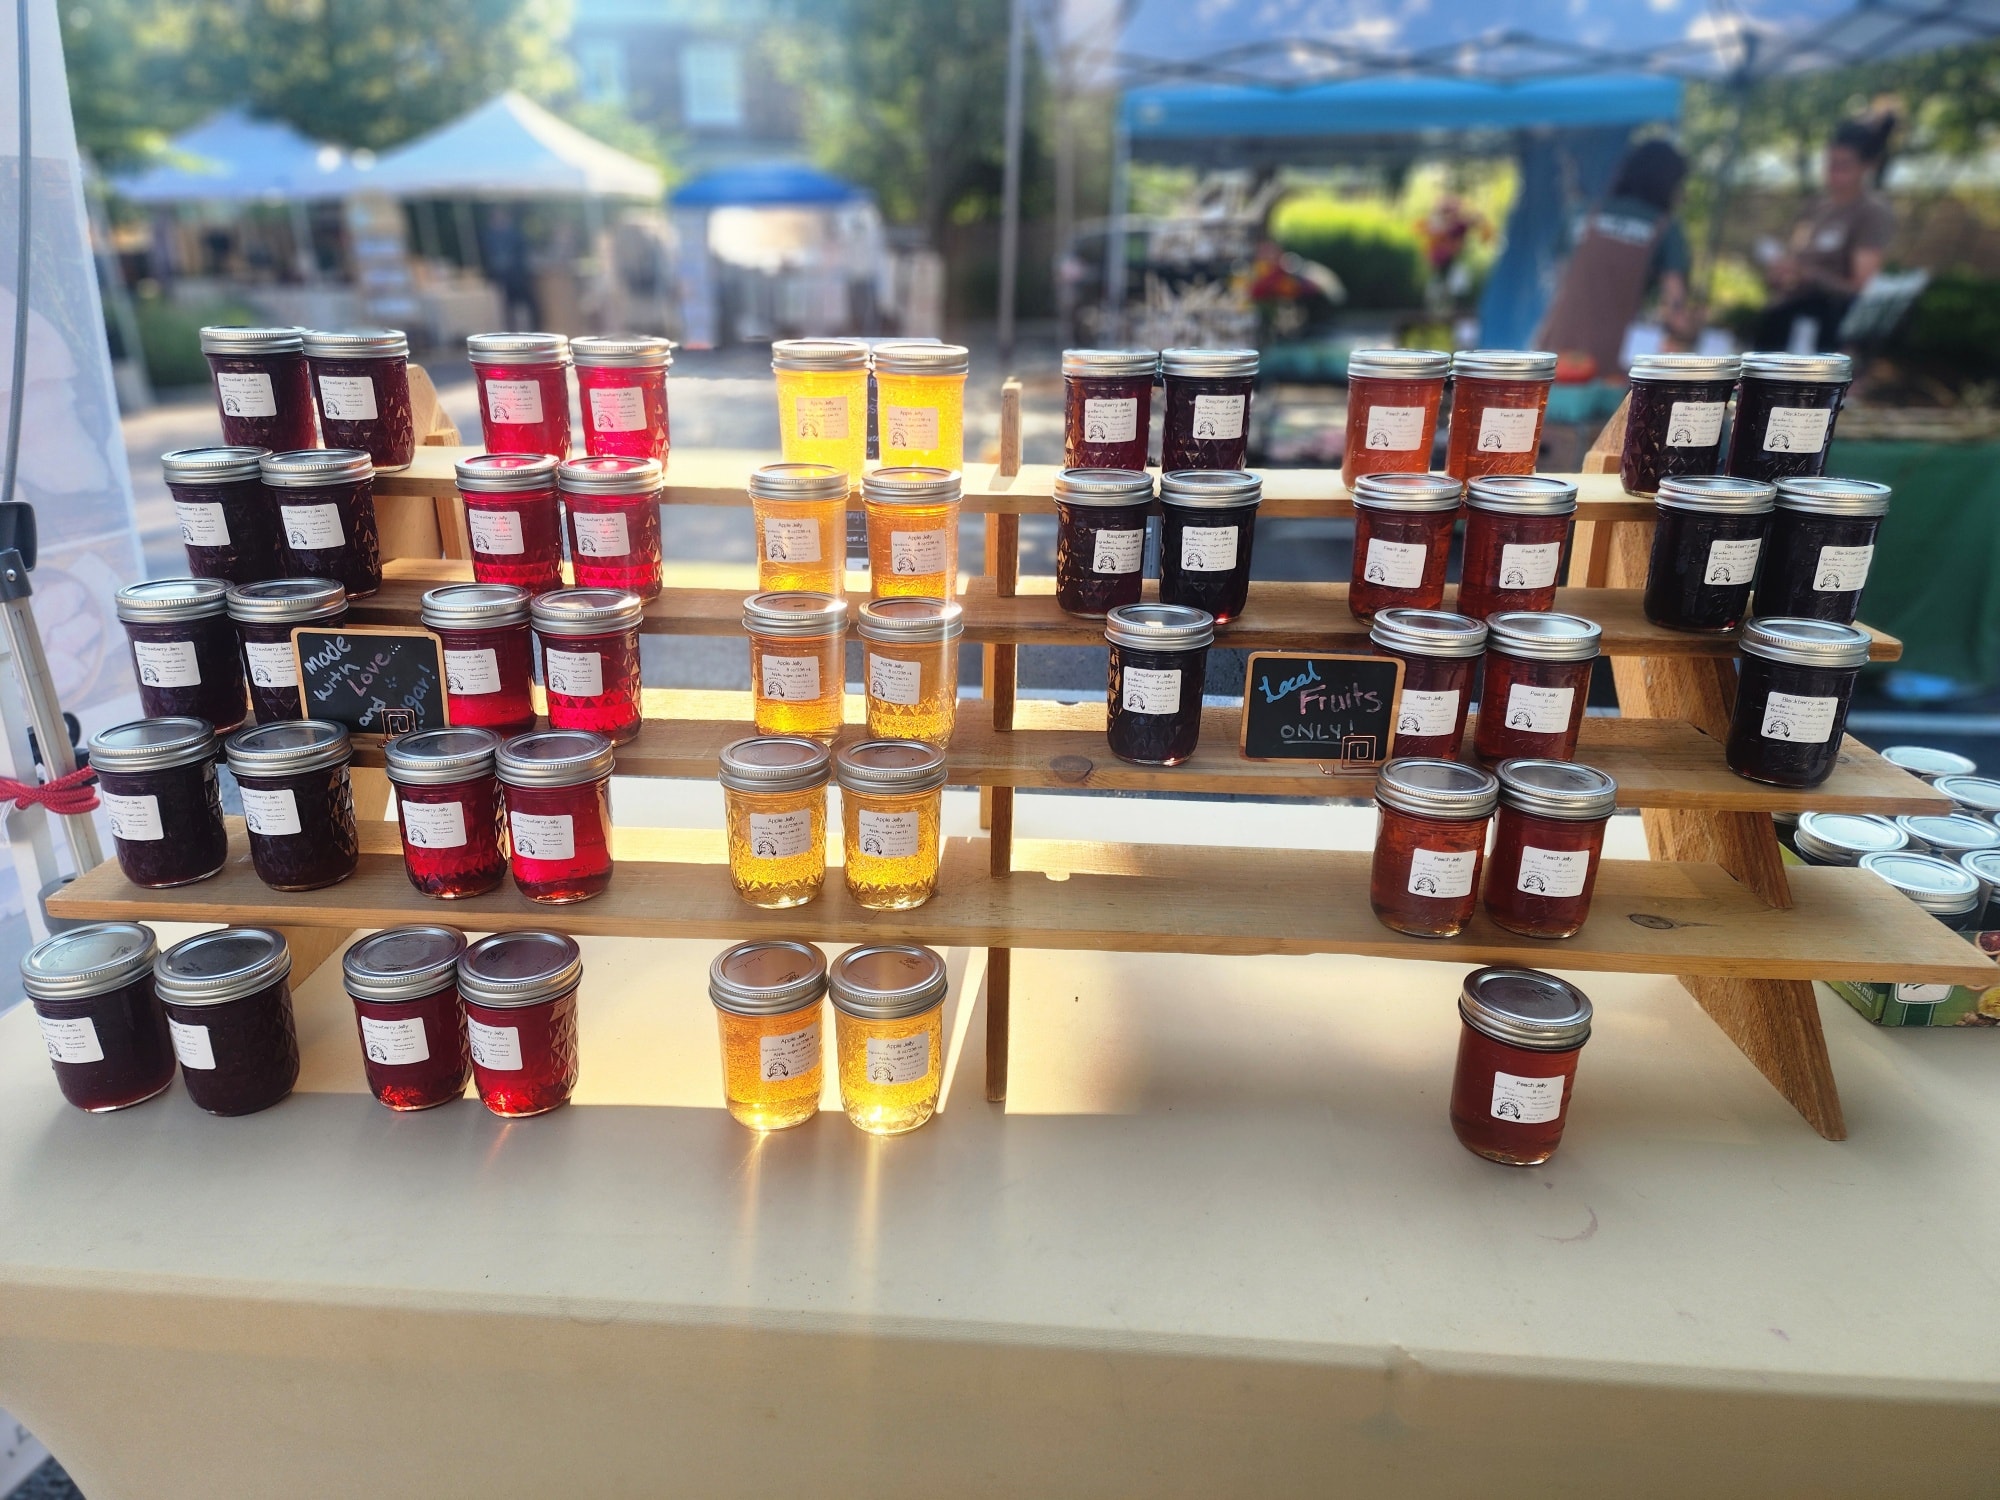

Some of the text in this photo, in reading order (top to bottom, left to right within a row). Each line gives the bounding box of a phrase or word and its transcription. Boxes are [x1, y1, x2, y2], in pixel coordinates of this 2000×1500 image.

[1258, 660, 1322, 704] Local
[359, 695, 387, 727] and
[1299, 682, 1384, 715] Fruits
[1280, 719, 1355, 741] ONLY!
